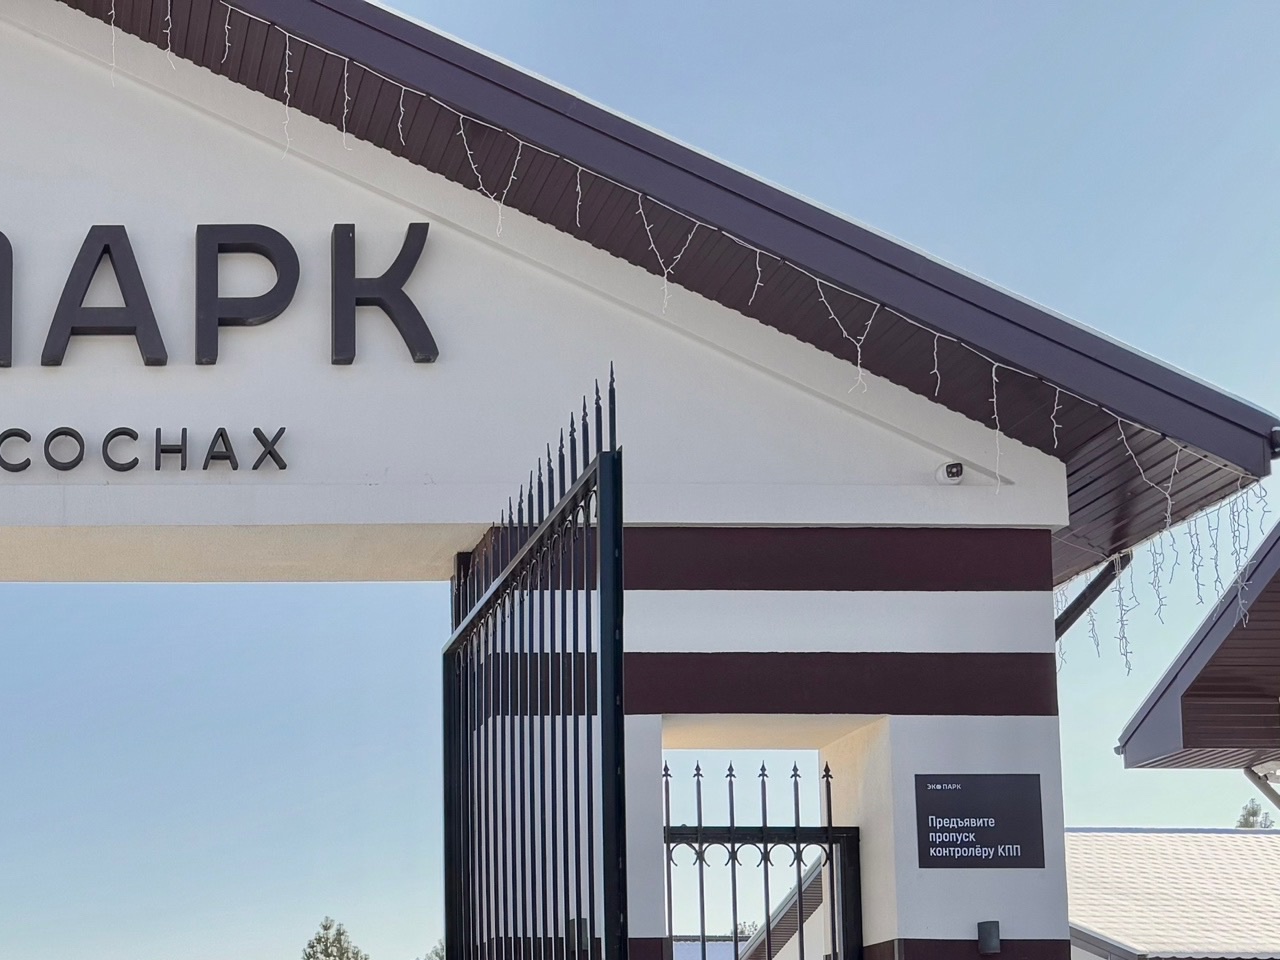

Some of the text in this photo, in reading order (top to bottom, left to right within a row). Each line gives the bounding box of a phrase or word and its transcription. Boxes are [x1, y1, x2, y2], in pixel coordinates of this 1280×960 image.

[928, 815, 996, 829] Предъявите
[929, 832, 976, 844] пропуск
[929, 844, 1021, 859] контролёру КПП
